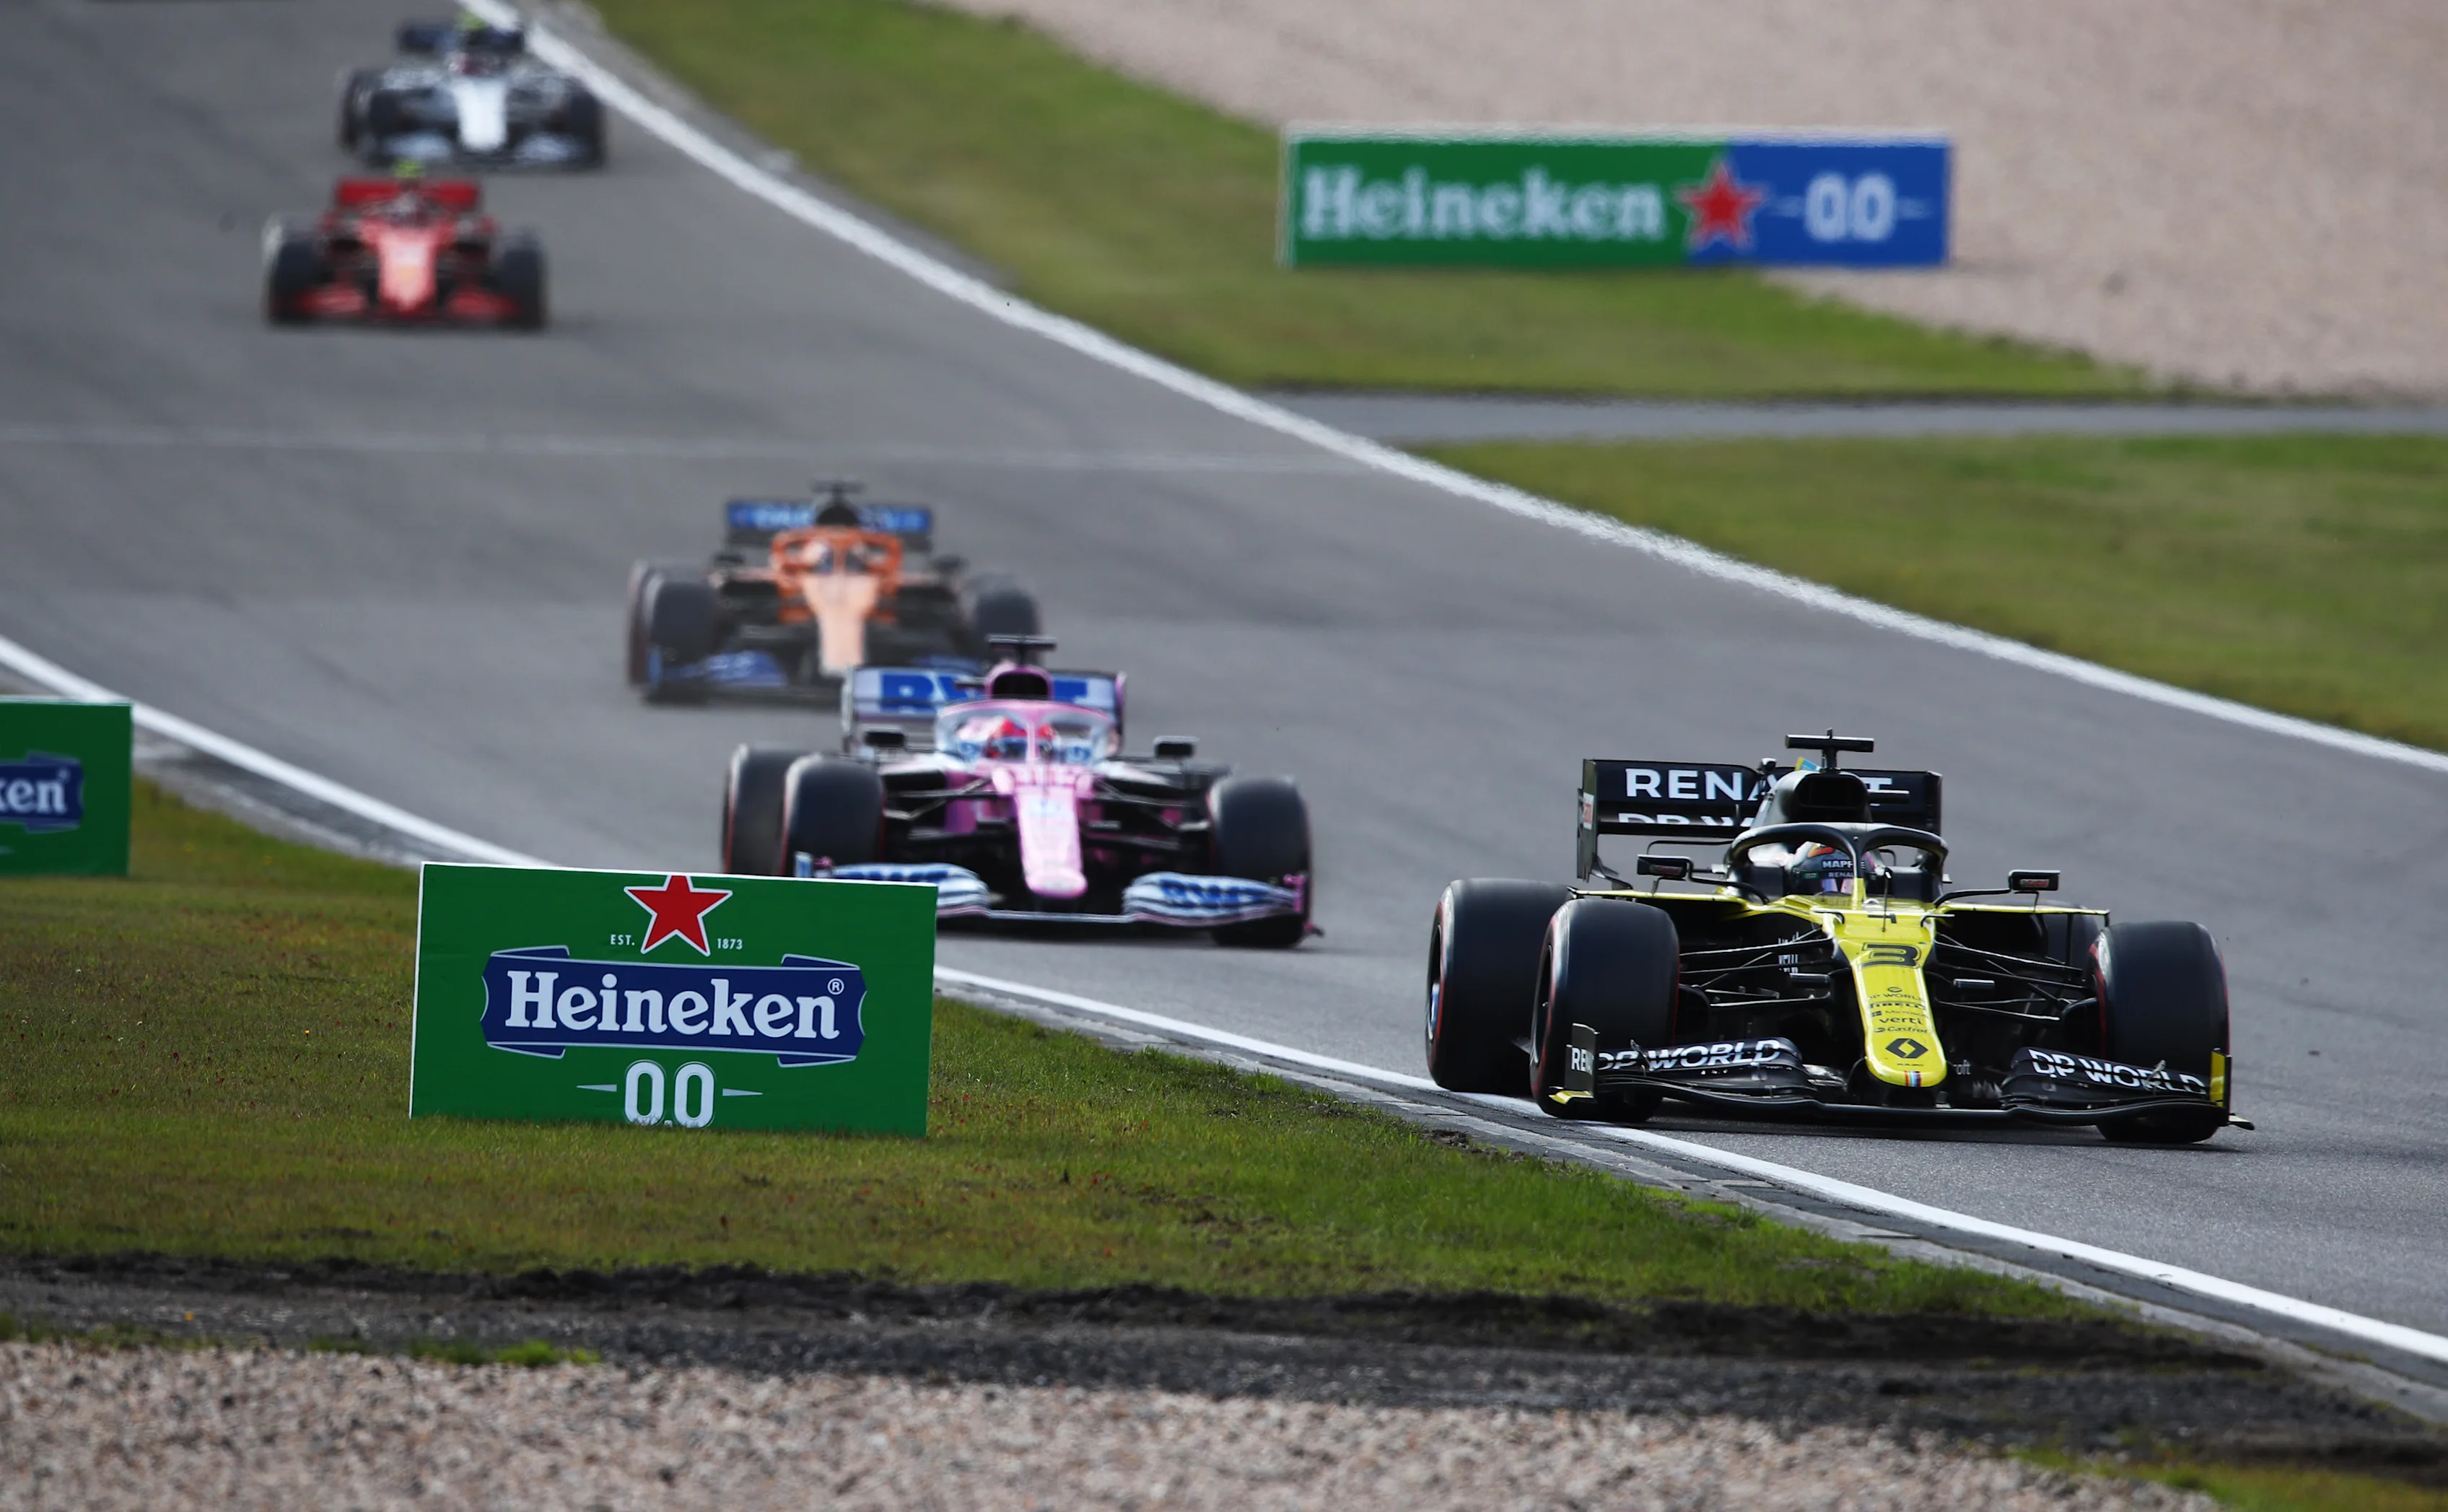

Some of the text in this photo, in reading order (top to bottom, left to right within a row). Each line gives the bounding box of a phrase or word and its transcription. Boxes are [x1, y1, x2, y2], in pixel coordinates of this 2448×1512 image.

[1302, 163, 1666, 242] Heineken
[610, 934, 743, 951] EST. 1873
[1862, 942, 1921, 969] 3
[1879, 1017, 1923, 1026] verti
[1648, 1039, 1781, 1069] WORLD
[2029, 1049, 2207, 1095] DP WORLD
